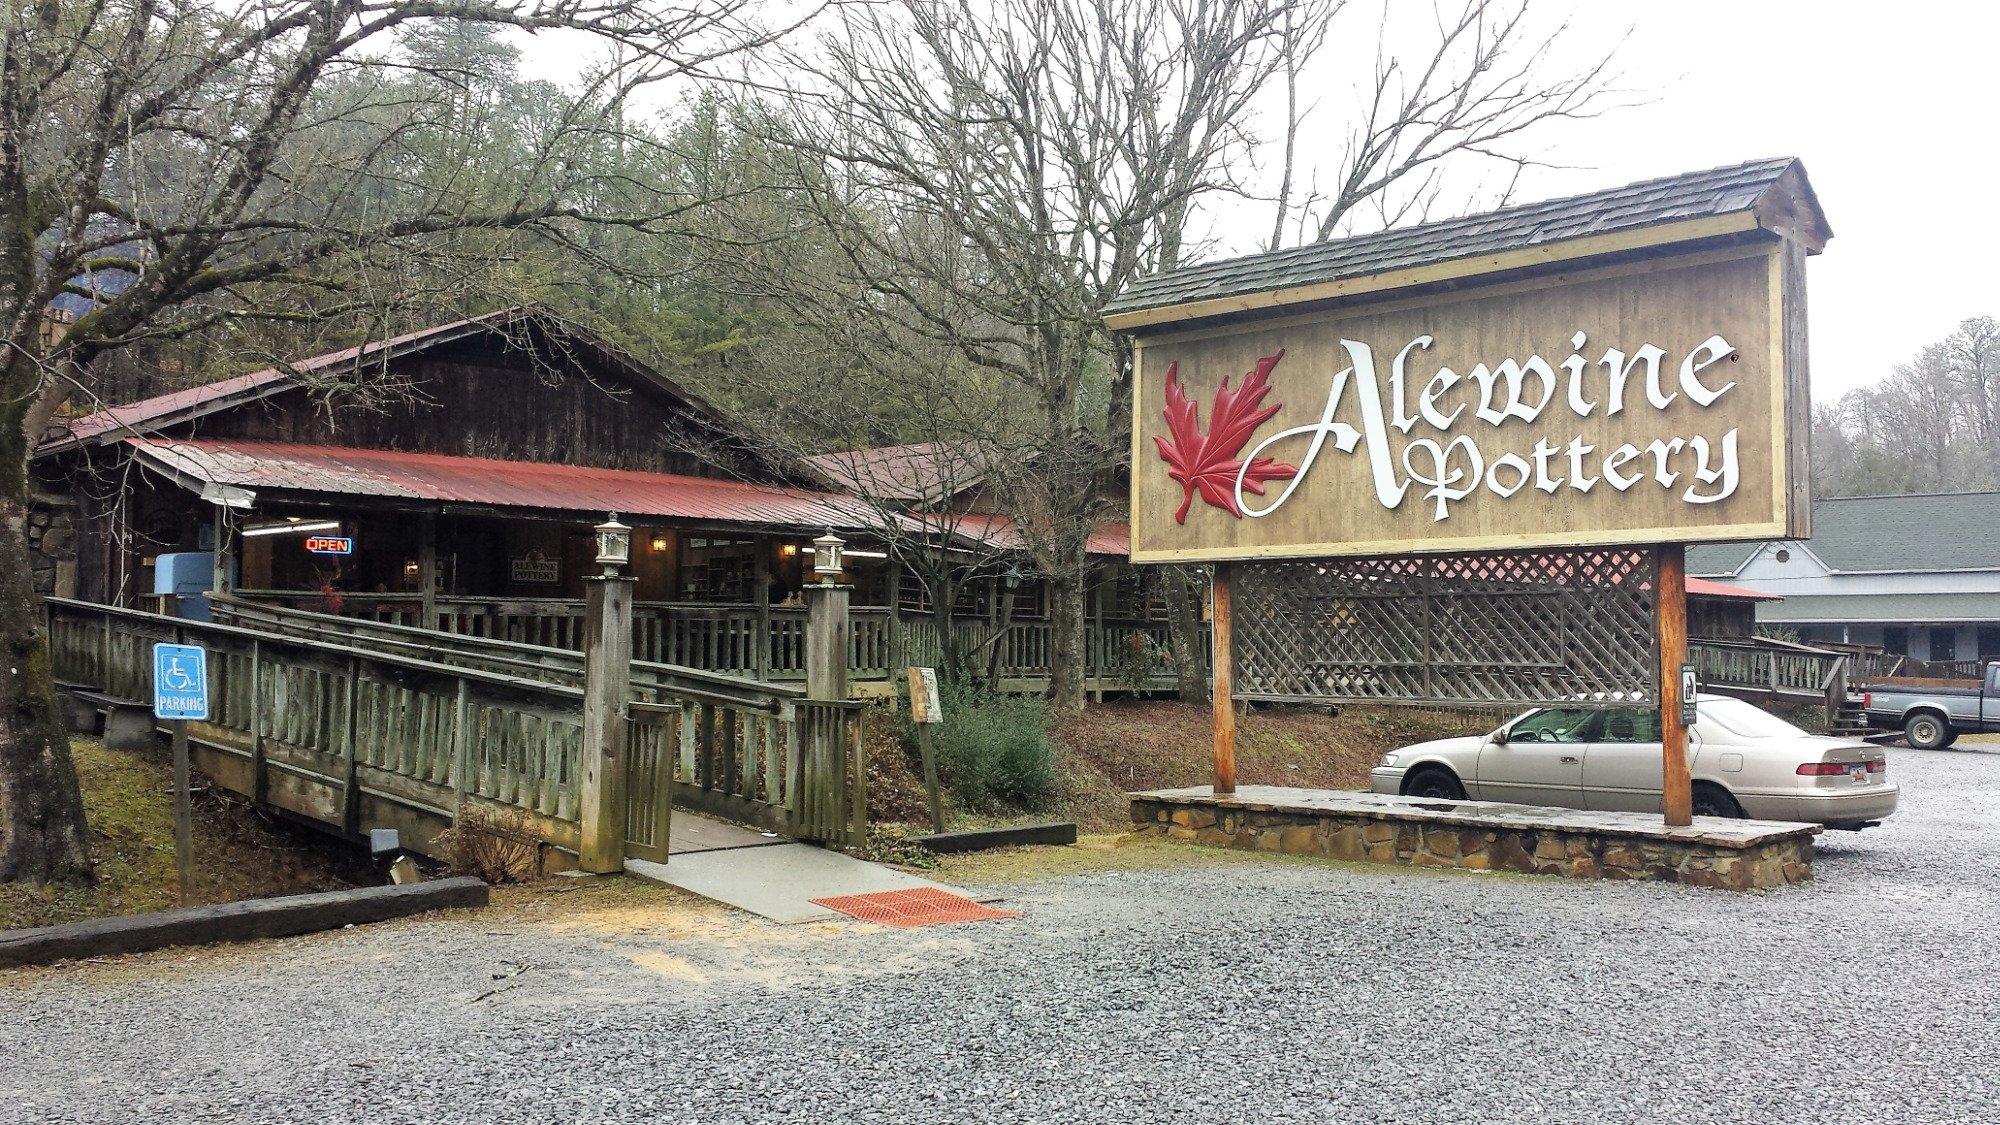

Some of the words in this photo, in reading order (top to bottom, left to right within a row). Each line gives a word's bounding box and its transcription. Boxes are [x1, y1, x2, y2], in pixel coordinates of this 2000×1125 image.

[1235, 331, 1739, 517] Alewine
[1402, 428, 1739, 522] Pottery
[306, 539, 348, 551] OPEN
[512, 561, 558, 570] ALEWINE
[514, 570, 556, 580] POTTERY
[159, 696, 205, 711] PARKING
